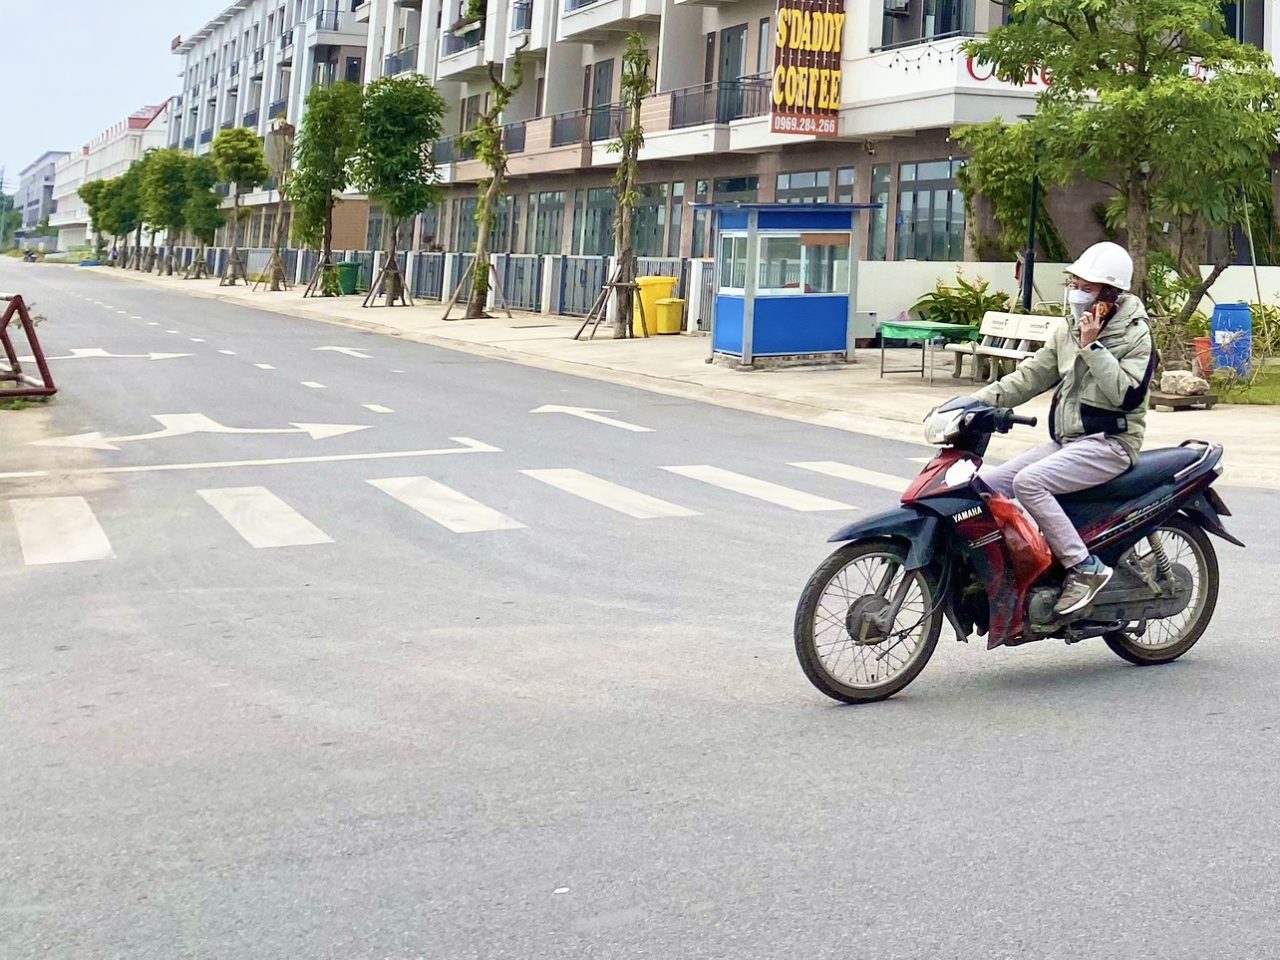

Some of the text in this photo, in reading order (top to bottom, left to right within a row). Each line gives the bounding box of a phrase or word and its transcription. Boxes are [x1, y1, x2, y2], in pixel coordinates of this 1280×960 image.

[776, 7, 845, 52] S'DADDY
[773, 65, 842, 110] COFFEE
[774, 116, 835, 133] 0969.284.266
[953, 506, 982, 523] YAMAHA
